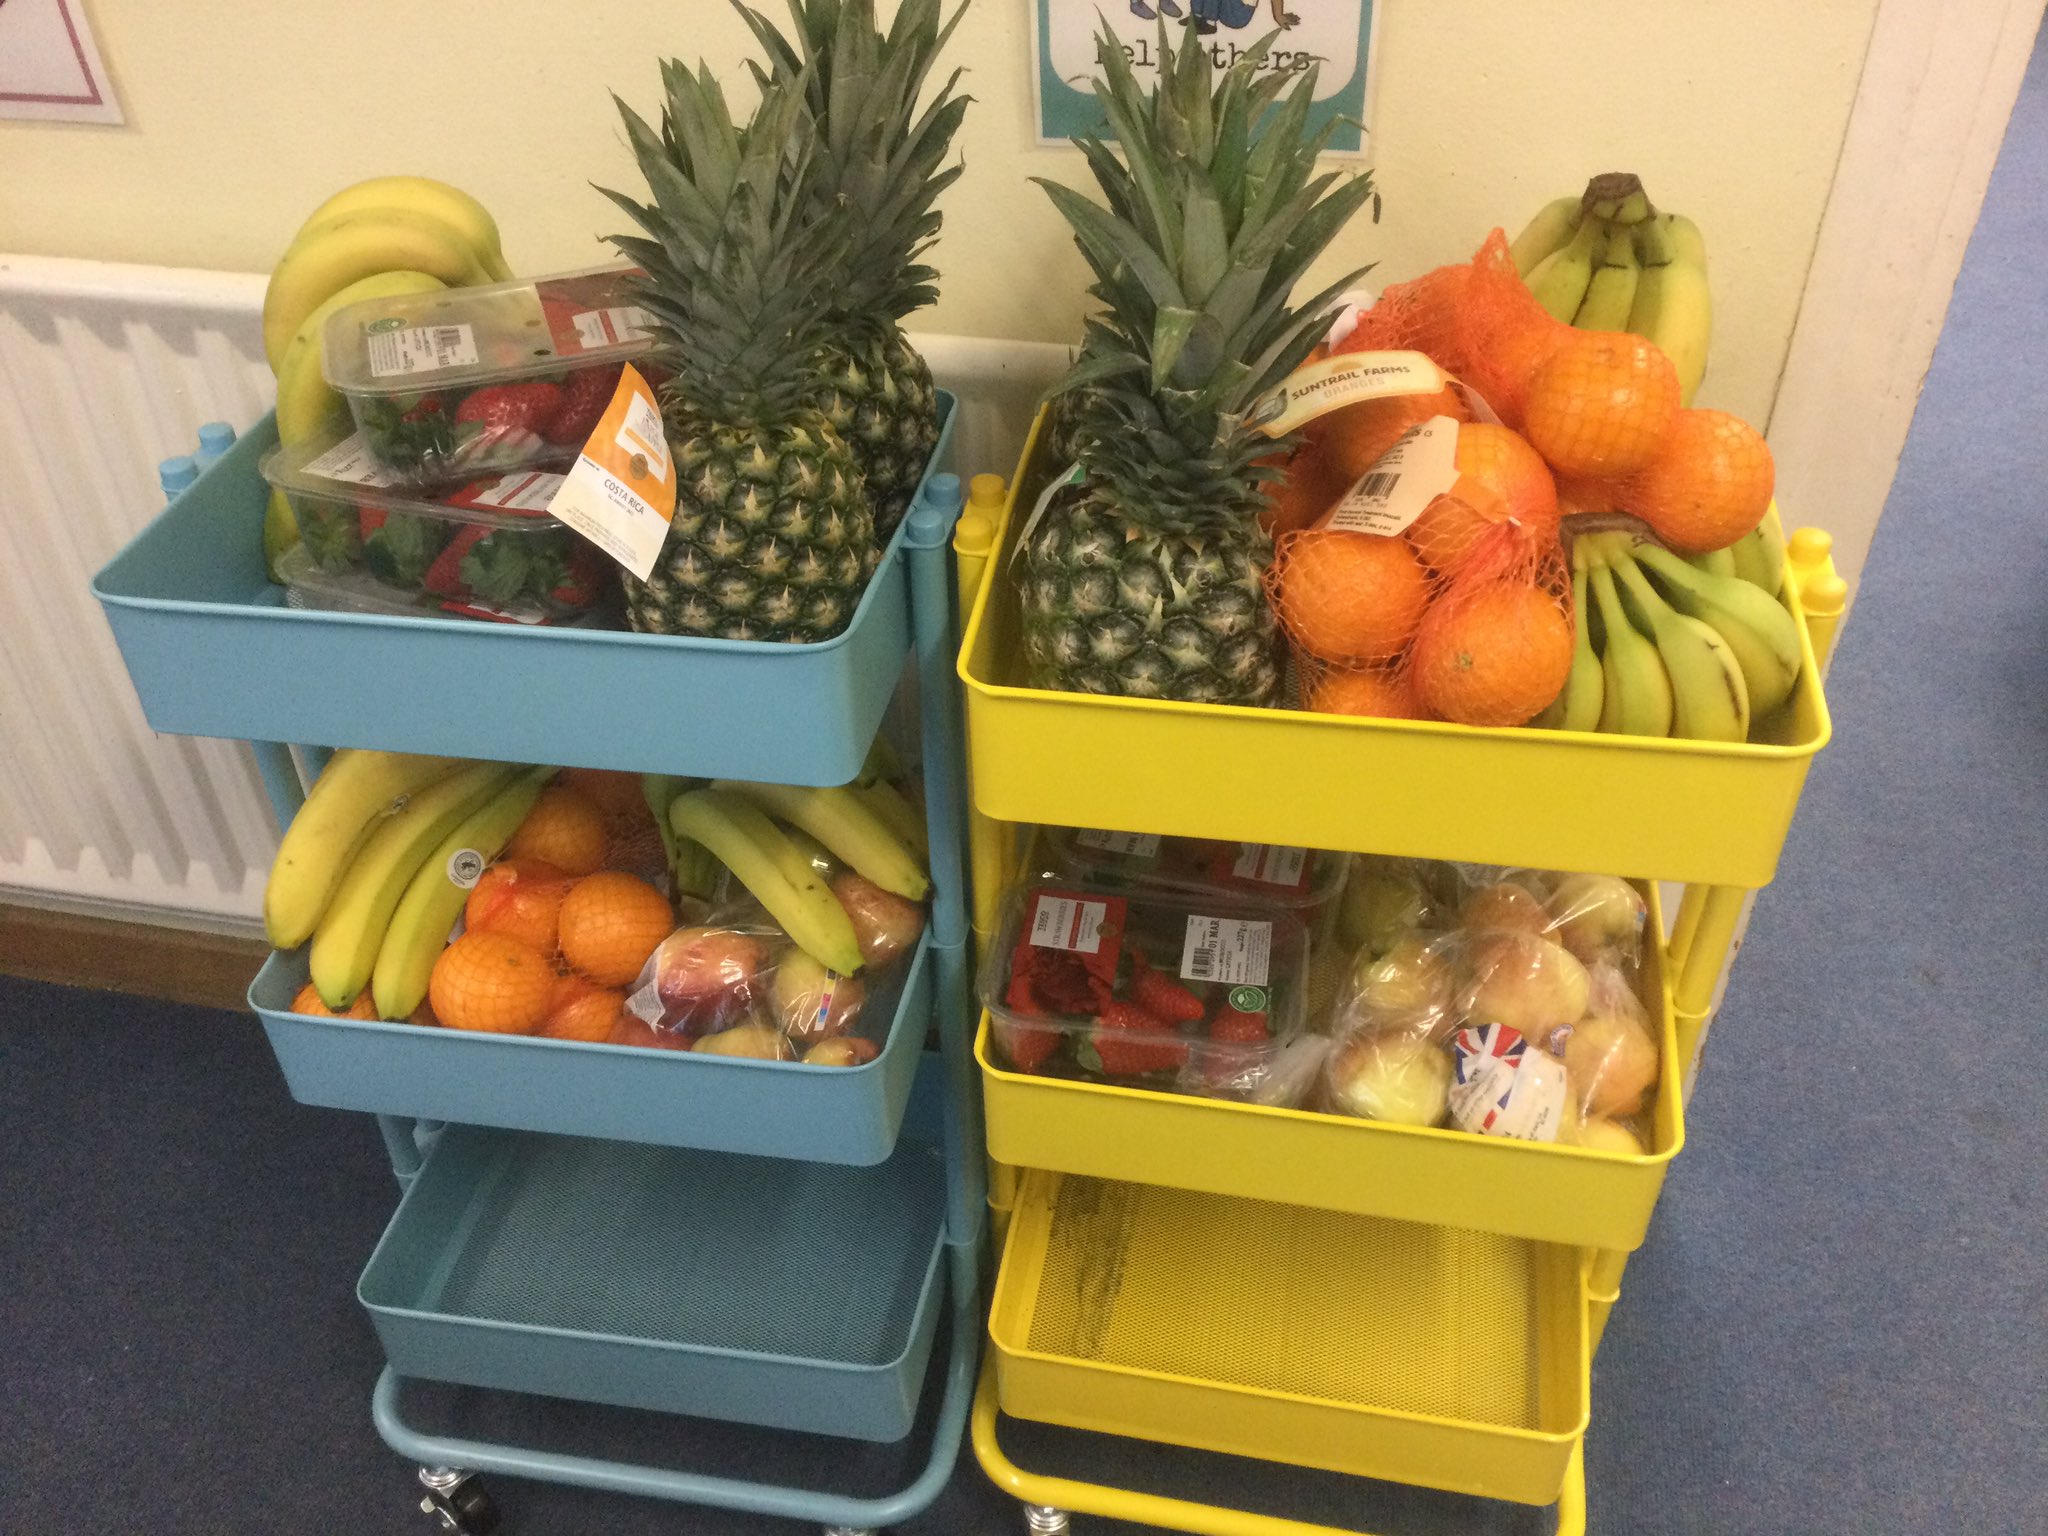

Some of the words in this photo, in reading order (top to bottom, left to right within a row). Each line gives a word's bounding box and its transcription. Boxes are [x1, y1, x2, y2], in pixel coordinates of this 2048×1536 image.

[1094, 38, 1178, 74] el
[1194, 41, 1310, 70] thers
[1292, 371, 1360, 400] SUNTRAIL
[1364, 366, 1410, 376] FARMS
[604, 479, 628, 502] COSTA
[628, 496, 645, 515] RICA
[1037, 910, 1047, 932] TESCO
[1208, 920, 1220, 939] MAR
